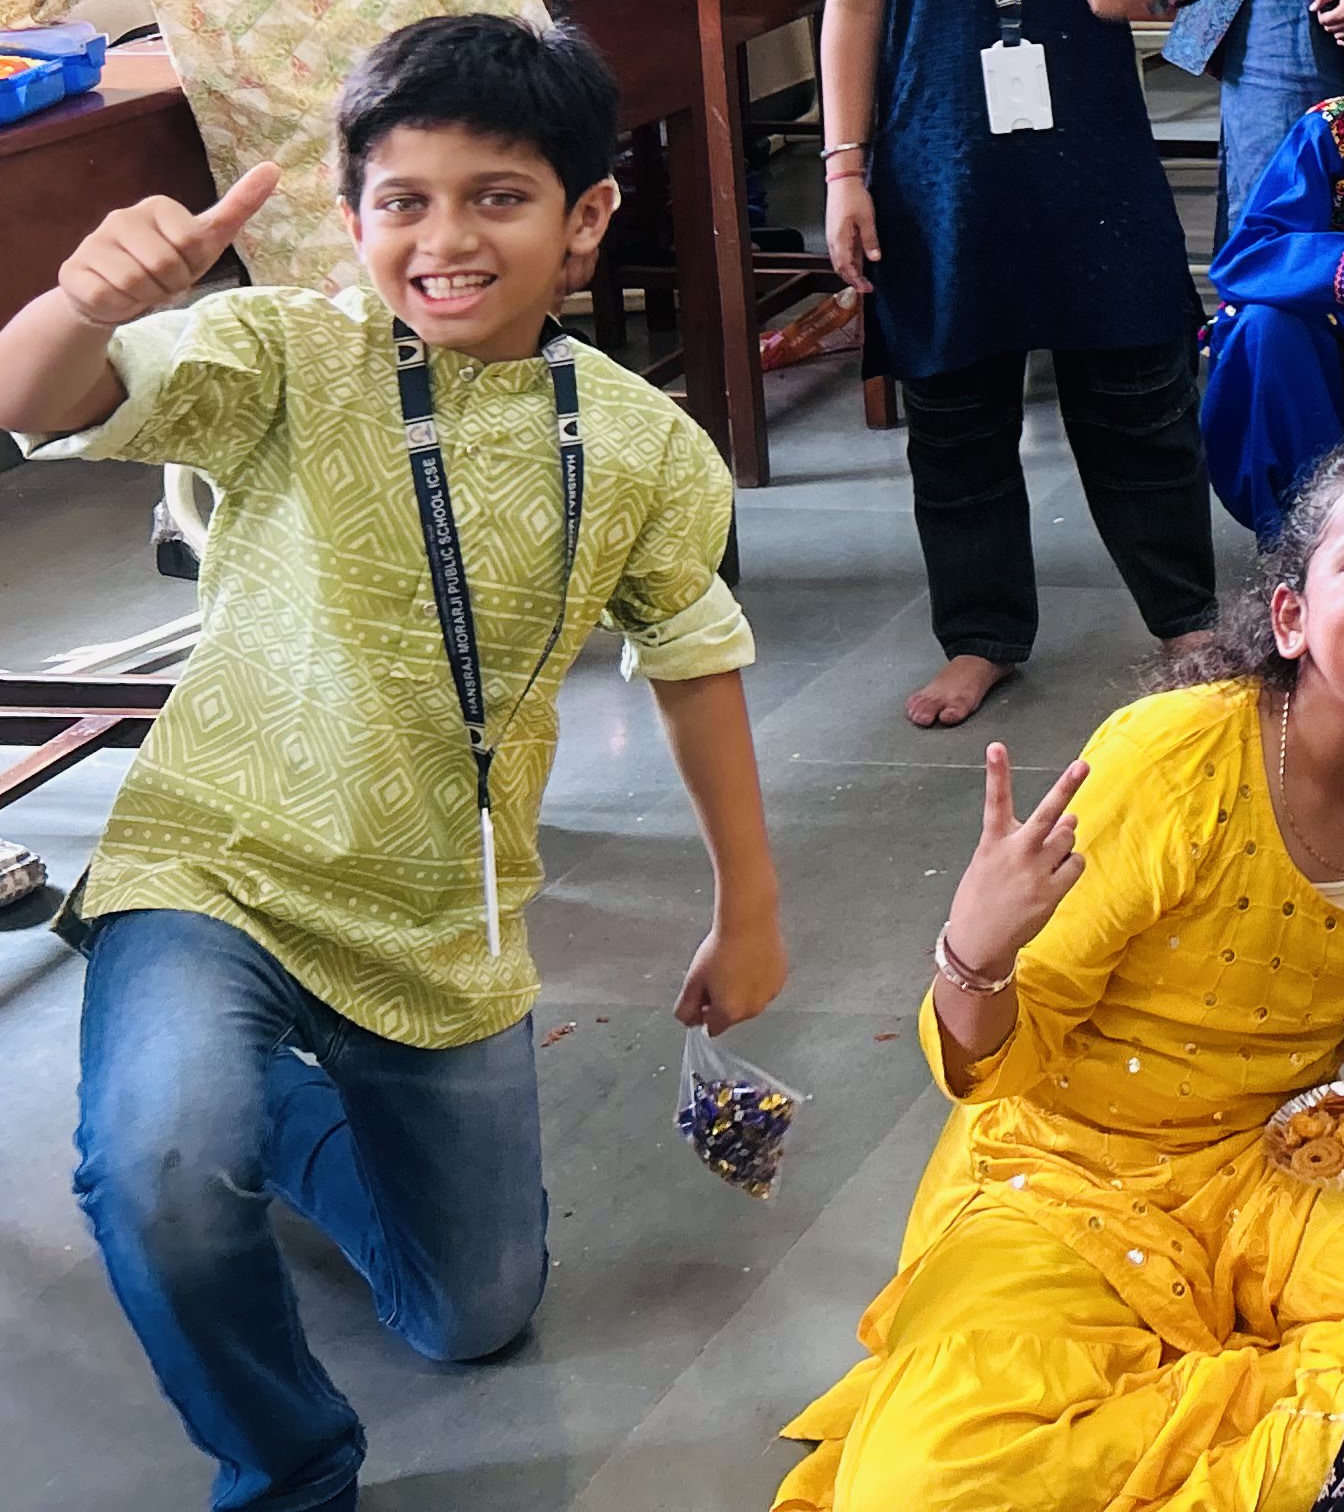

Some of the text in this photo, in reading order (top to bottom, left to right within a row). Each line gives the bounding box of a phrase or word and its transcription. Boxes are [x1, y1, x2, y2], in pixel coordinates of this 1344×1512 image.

[566, 454, 579, 516] HANSRAJ
[421, 456, 479, 714] HANSRAJ MORARJI PUBLIC SCHOOL ICSE
